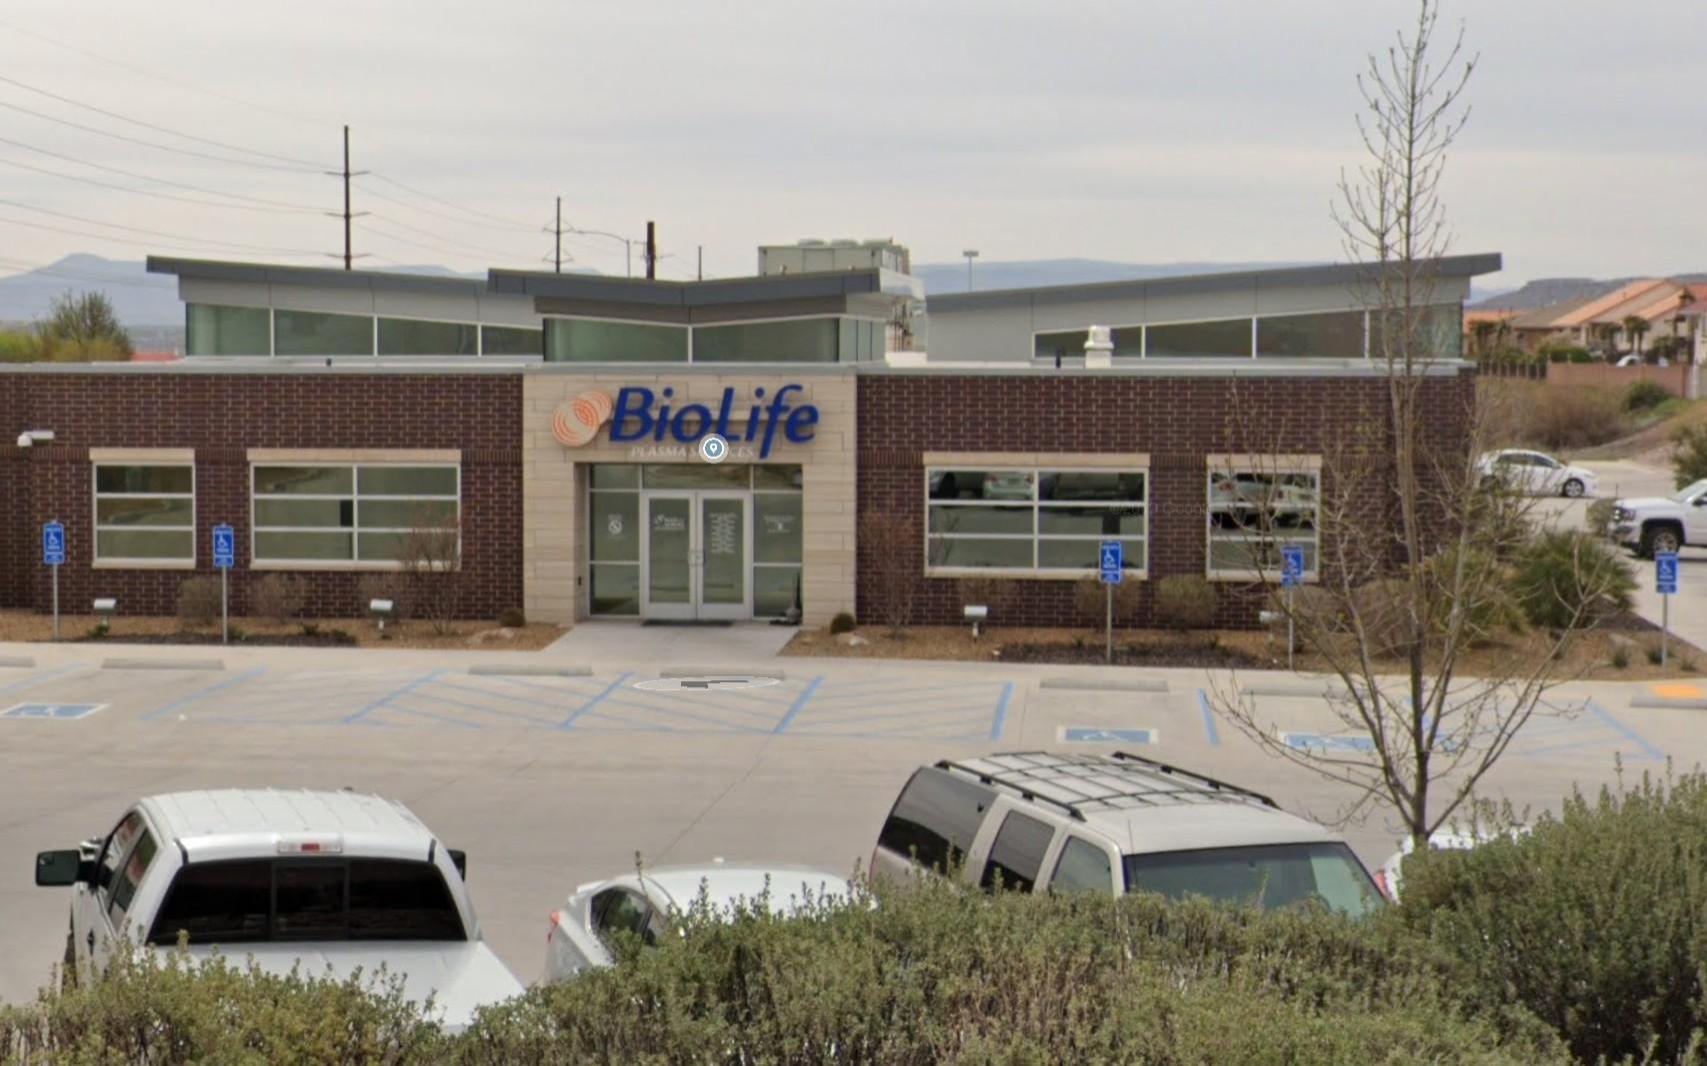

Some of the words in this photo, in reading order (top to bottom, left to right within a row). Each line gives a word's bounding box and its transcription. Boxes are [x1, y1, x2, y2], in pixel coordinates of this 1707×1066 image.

[609, 384, 820, 459] BioLife
[632, 445, 688, 458] PLASMA
[690, 445, 754, 458] SCES
